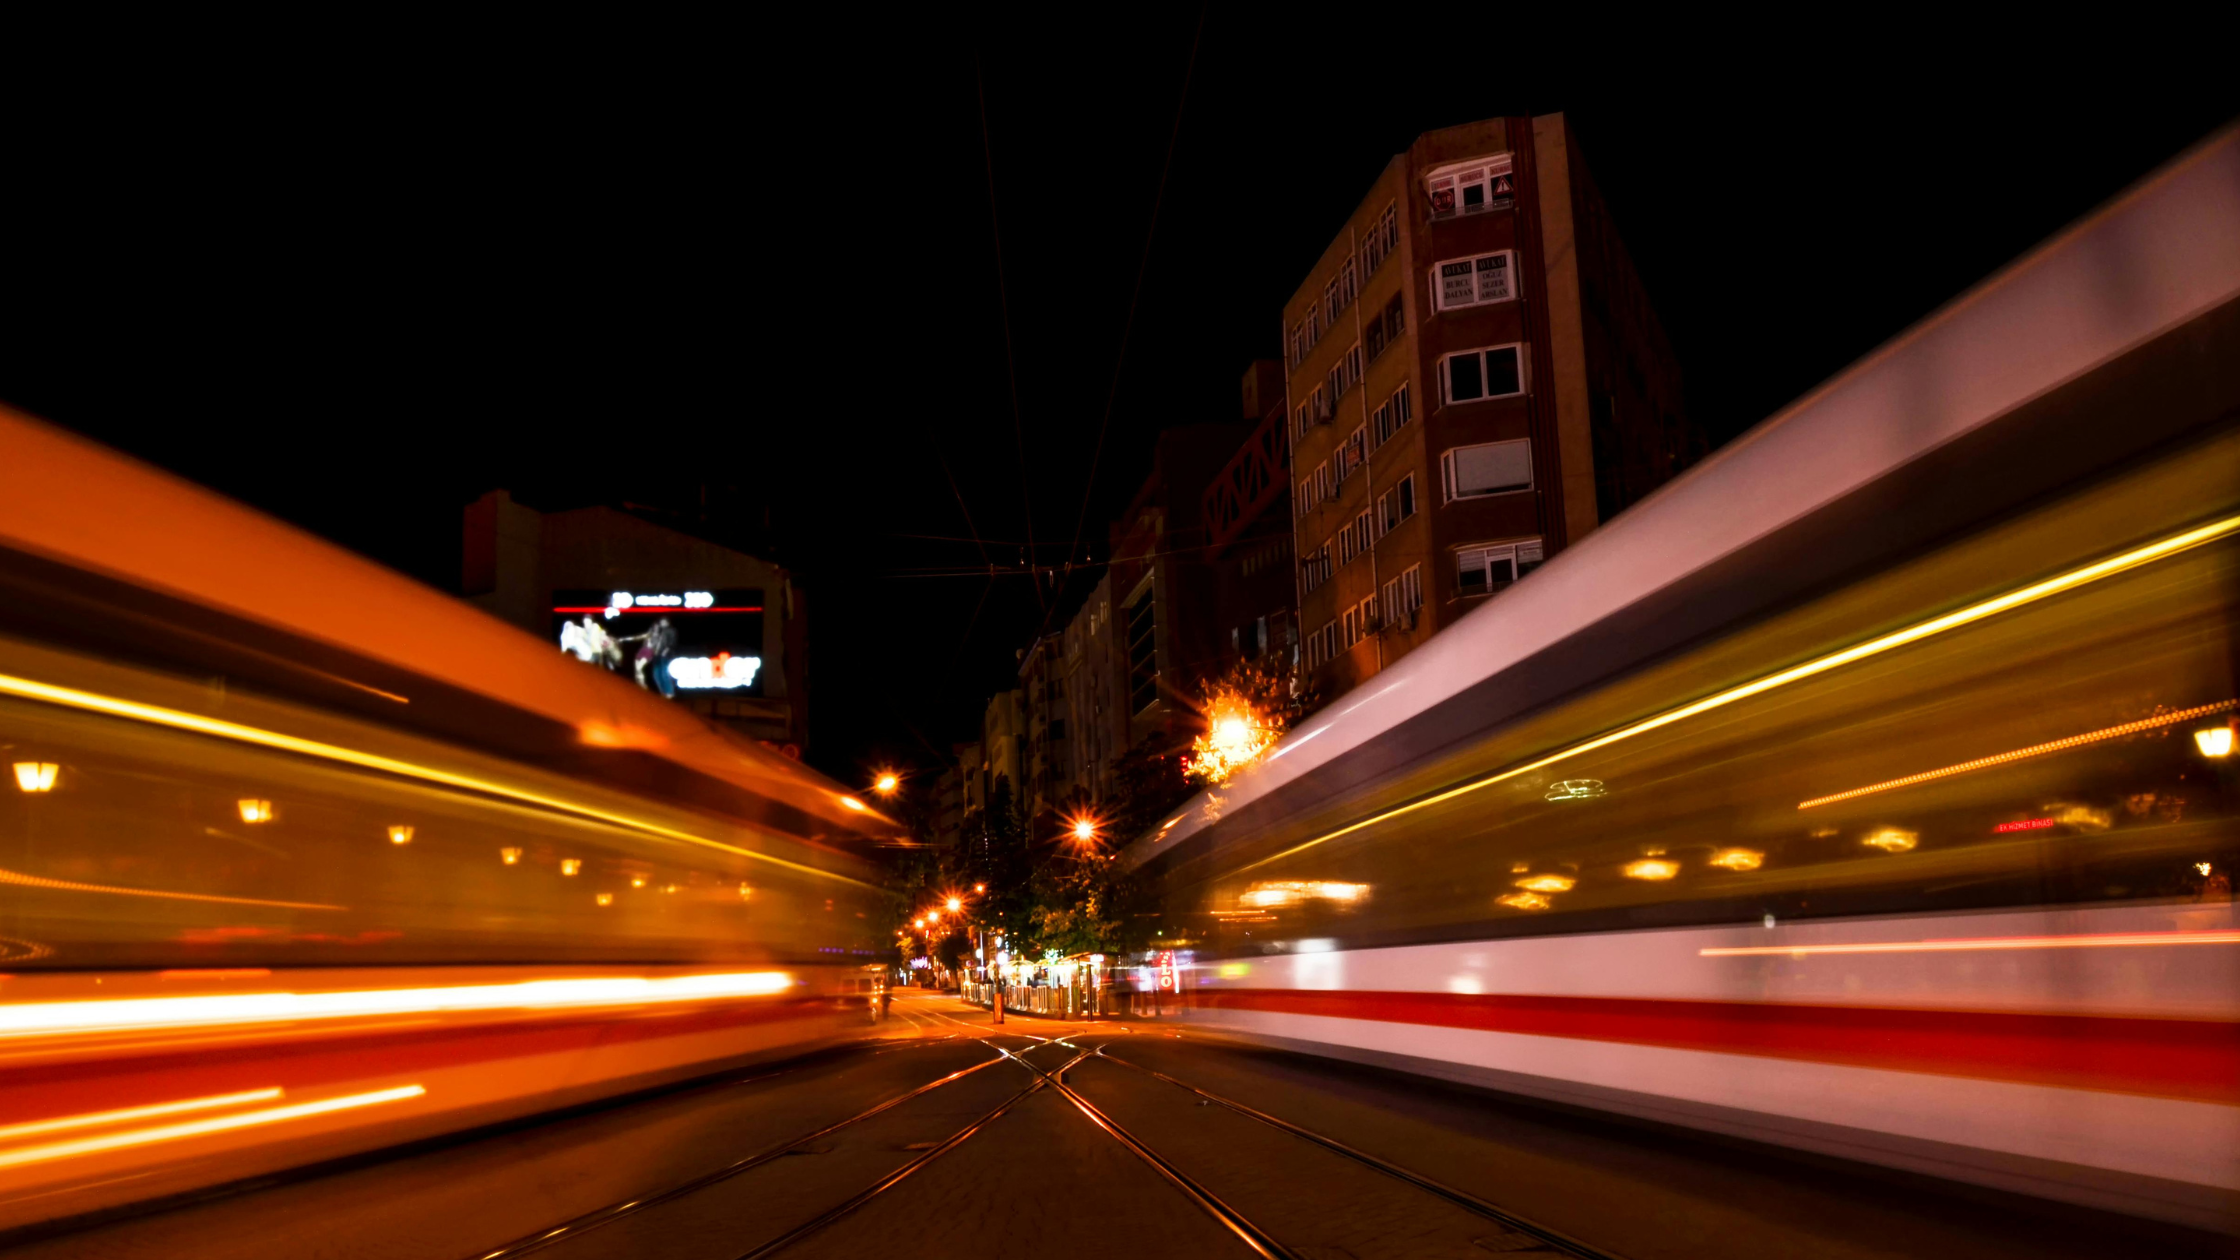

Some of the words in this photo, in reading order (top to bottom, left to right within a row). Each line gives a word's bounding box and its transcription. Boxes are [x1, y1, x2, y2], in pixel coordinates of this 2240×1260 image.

[1437, 195, 1451, 206] DUR
[1479, 257, 1505, 270] AVUKAT
[1445, 263, 1470, 275] AVUKAT
[1482, 280, 1504, 289] SEZER
[1445, 289, 1473, 299] DALYAN
[1481, 289, 1508, 299] ARSLAN
[2008, 821, 2031, 830] HİZMET
